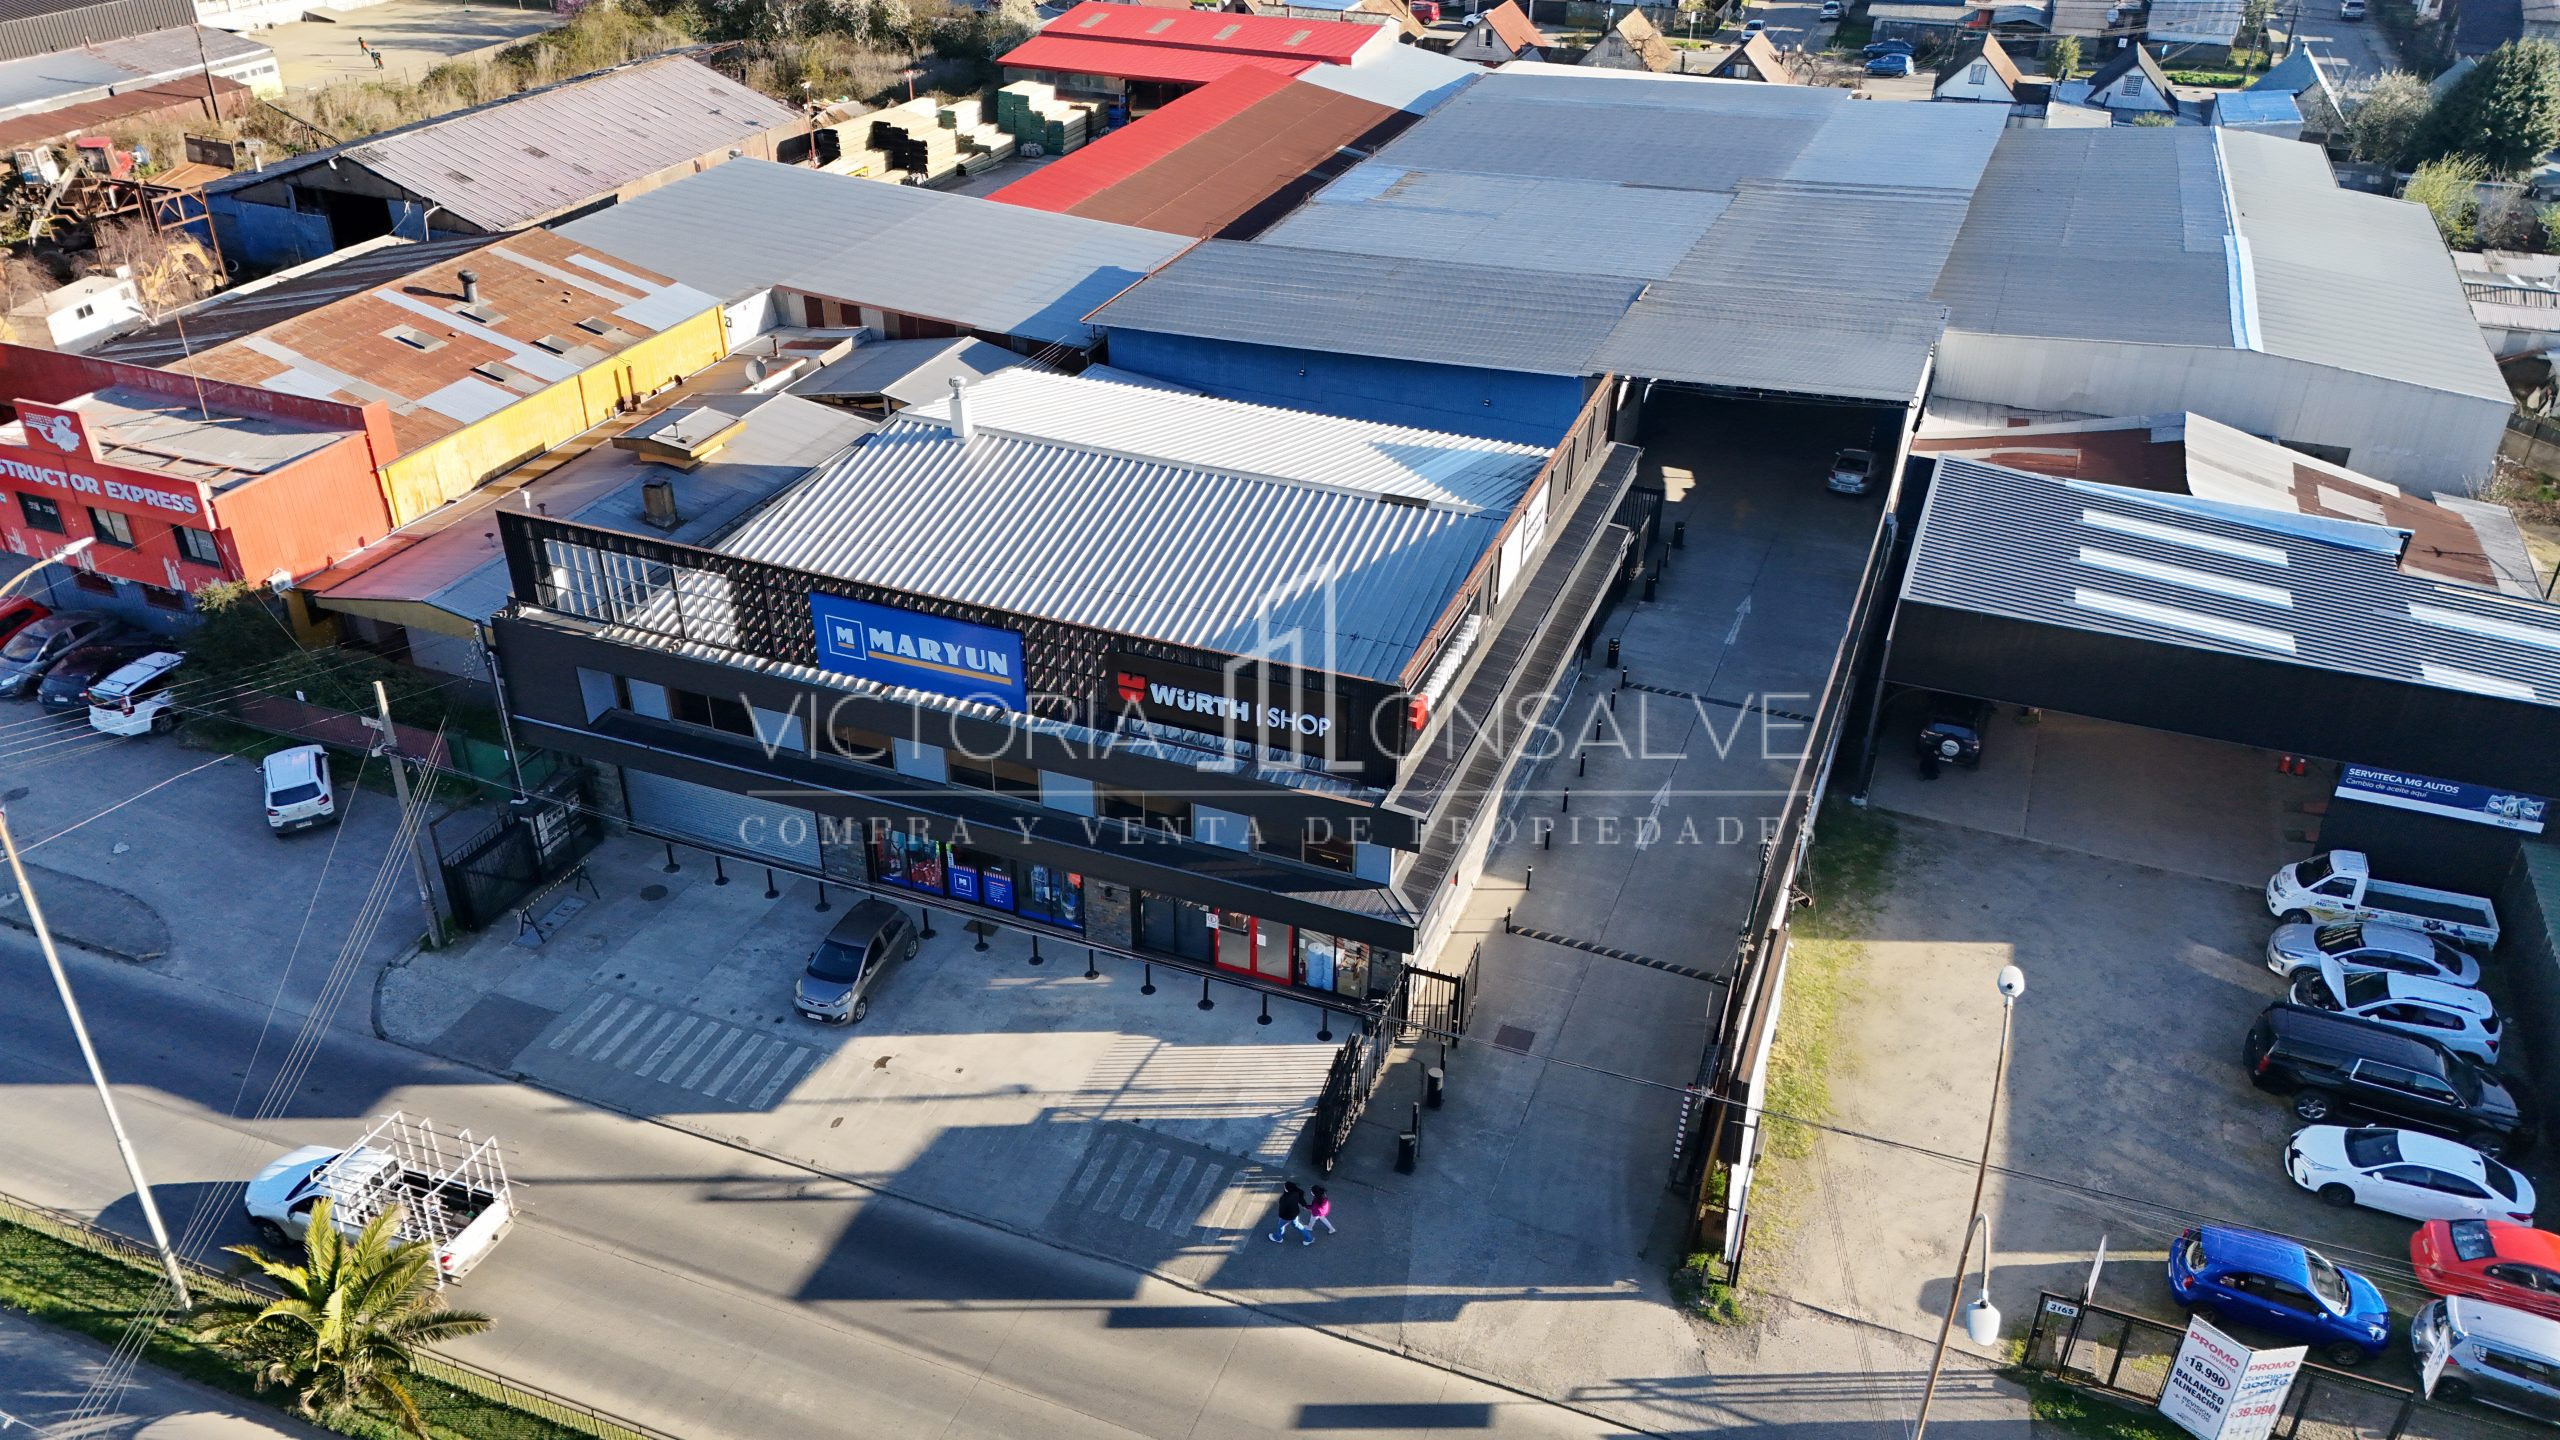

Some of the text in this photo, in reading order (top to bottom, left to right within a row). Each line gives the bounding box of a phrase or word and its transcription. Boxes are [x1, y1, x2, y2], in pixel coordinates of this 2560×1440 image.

[103, 479, 198, 514] EXPRESS
[835, 625, 1009, 676] M MARYUN
[1149, 683, 1332, 738] WÜRTH SHOP
[2345, 777, 2375, 788] Cambio
[2386, 785, 2410, 795] aceite
[2348, 767, 2460, 794] SERVITECA MG AUTOS
[2050, 1303, 2075, 1315] 3165
[2189, 1330, 2239, 1368] PROMO
[2248, 1360, 2296, 1372] PROMO
[2175, 1367, 2225, 1405] BALANCEO
[2184, 1355, 2225, 1388] $18.990
